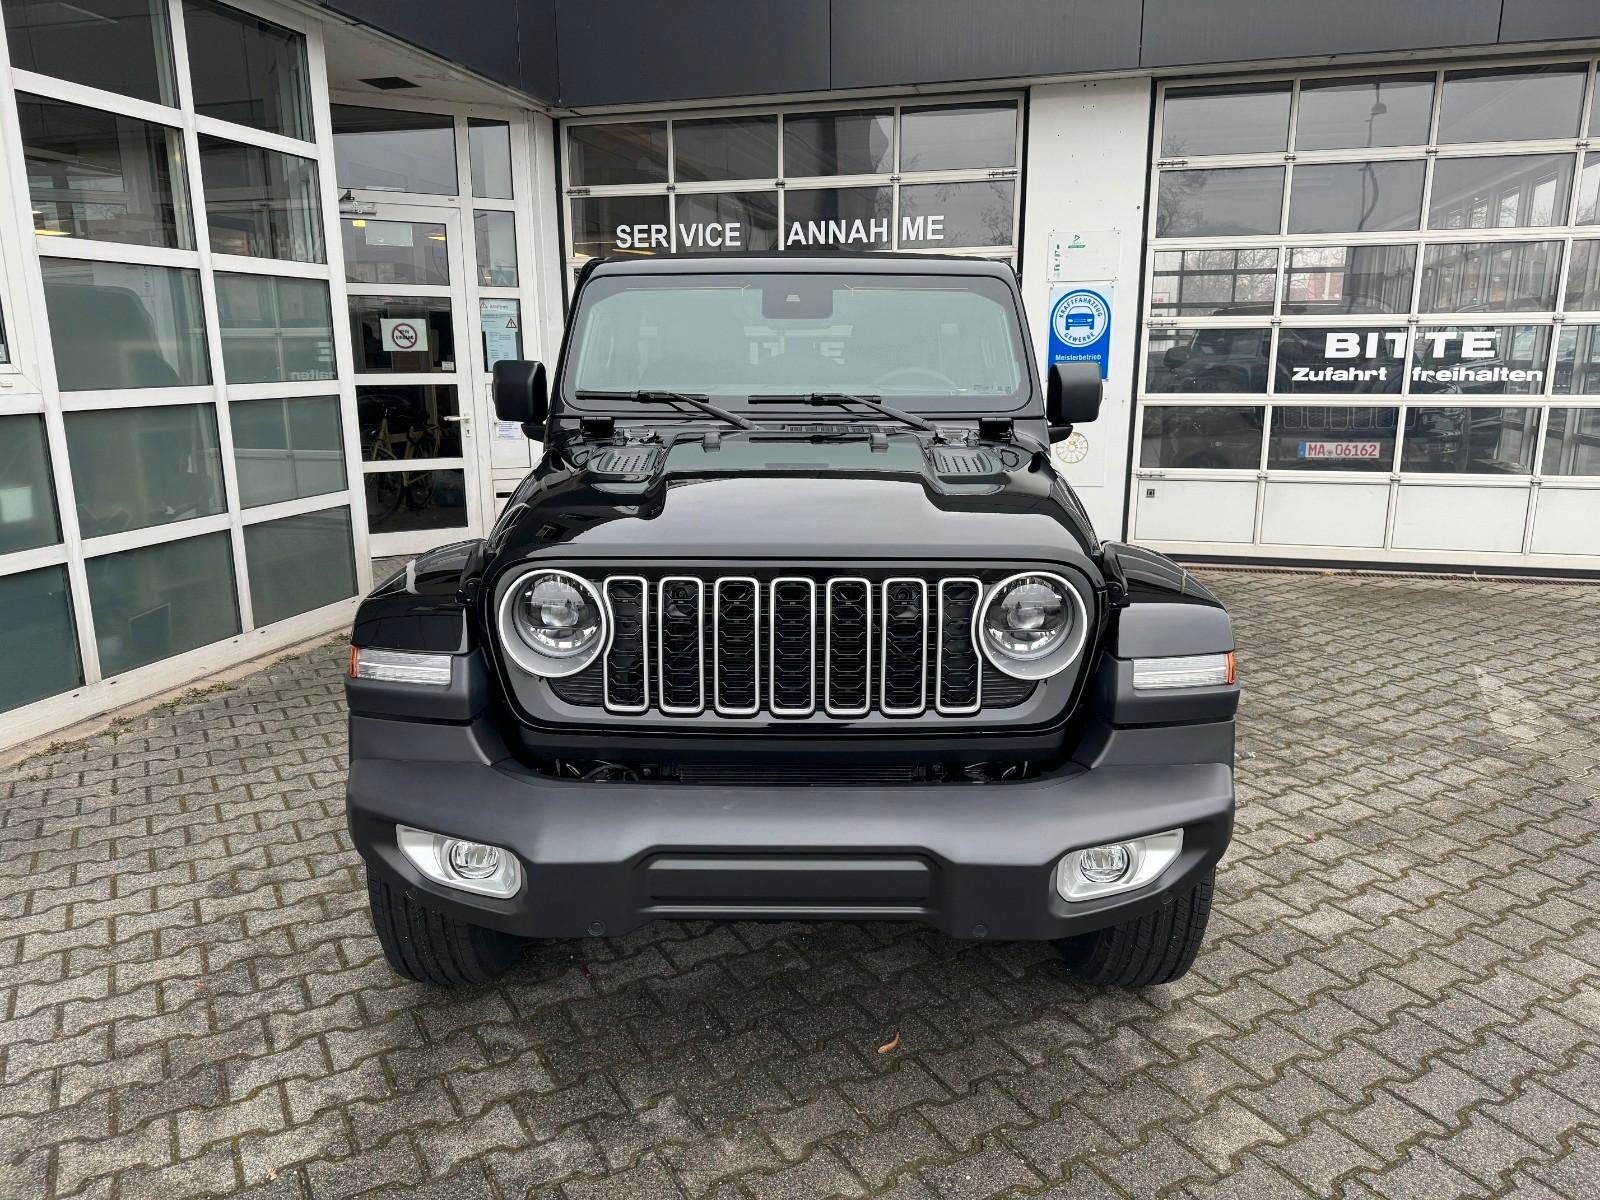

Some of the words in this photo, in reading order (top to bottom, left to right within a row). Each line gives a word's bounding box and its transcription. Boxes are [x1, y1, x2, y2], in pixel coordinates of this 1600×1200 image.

[1058, 297, 1103, 319] KRAFTFAHRZEUG
[1064, 331, 1095, 343] GEWERBE
[1324, 331, 1497, 359] BITTE
[1291, 367, 1387, 382] Zufahrt
[1412, 367, 1543, 382] freihalten
[1308, 444, 1325, 456] MA
[1335, 444, 1377, 456] 06162
